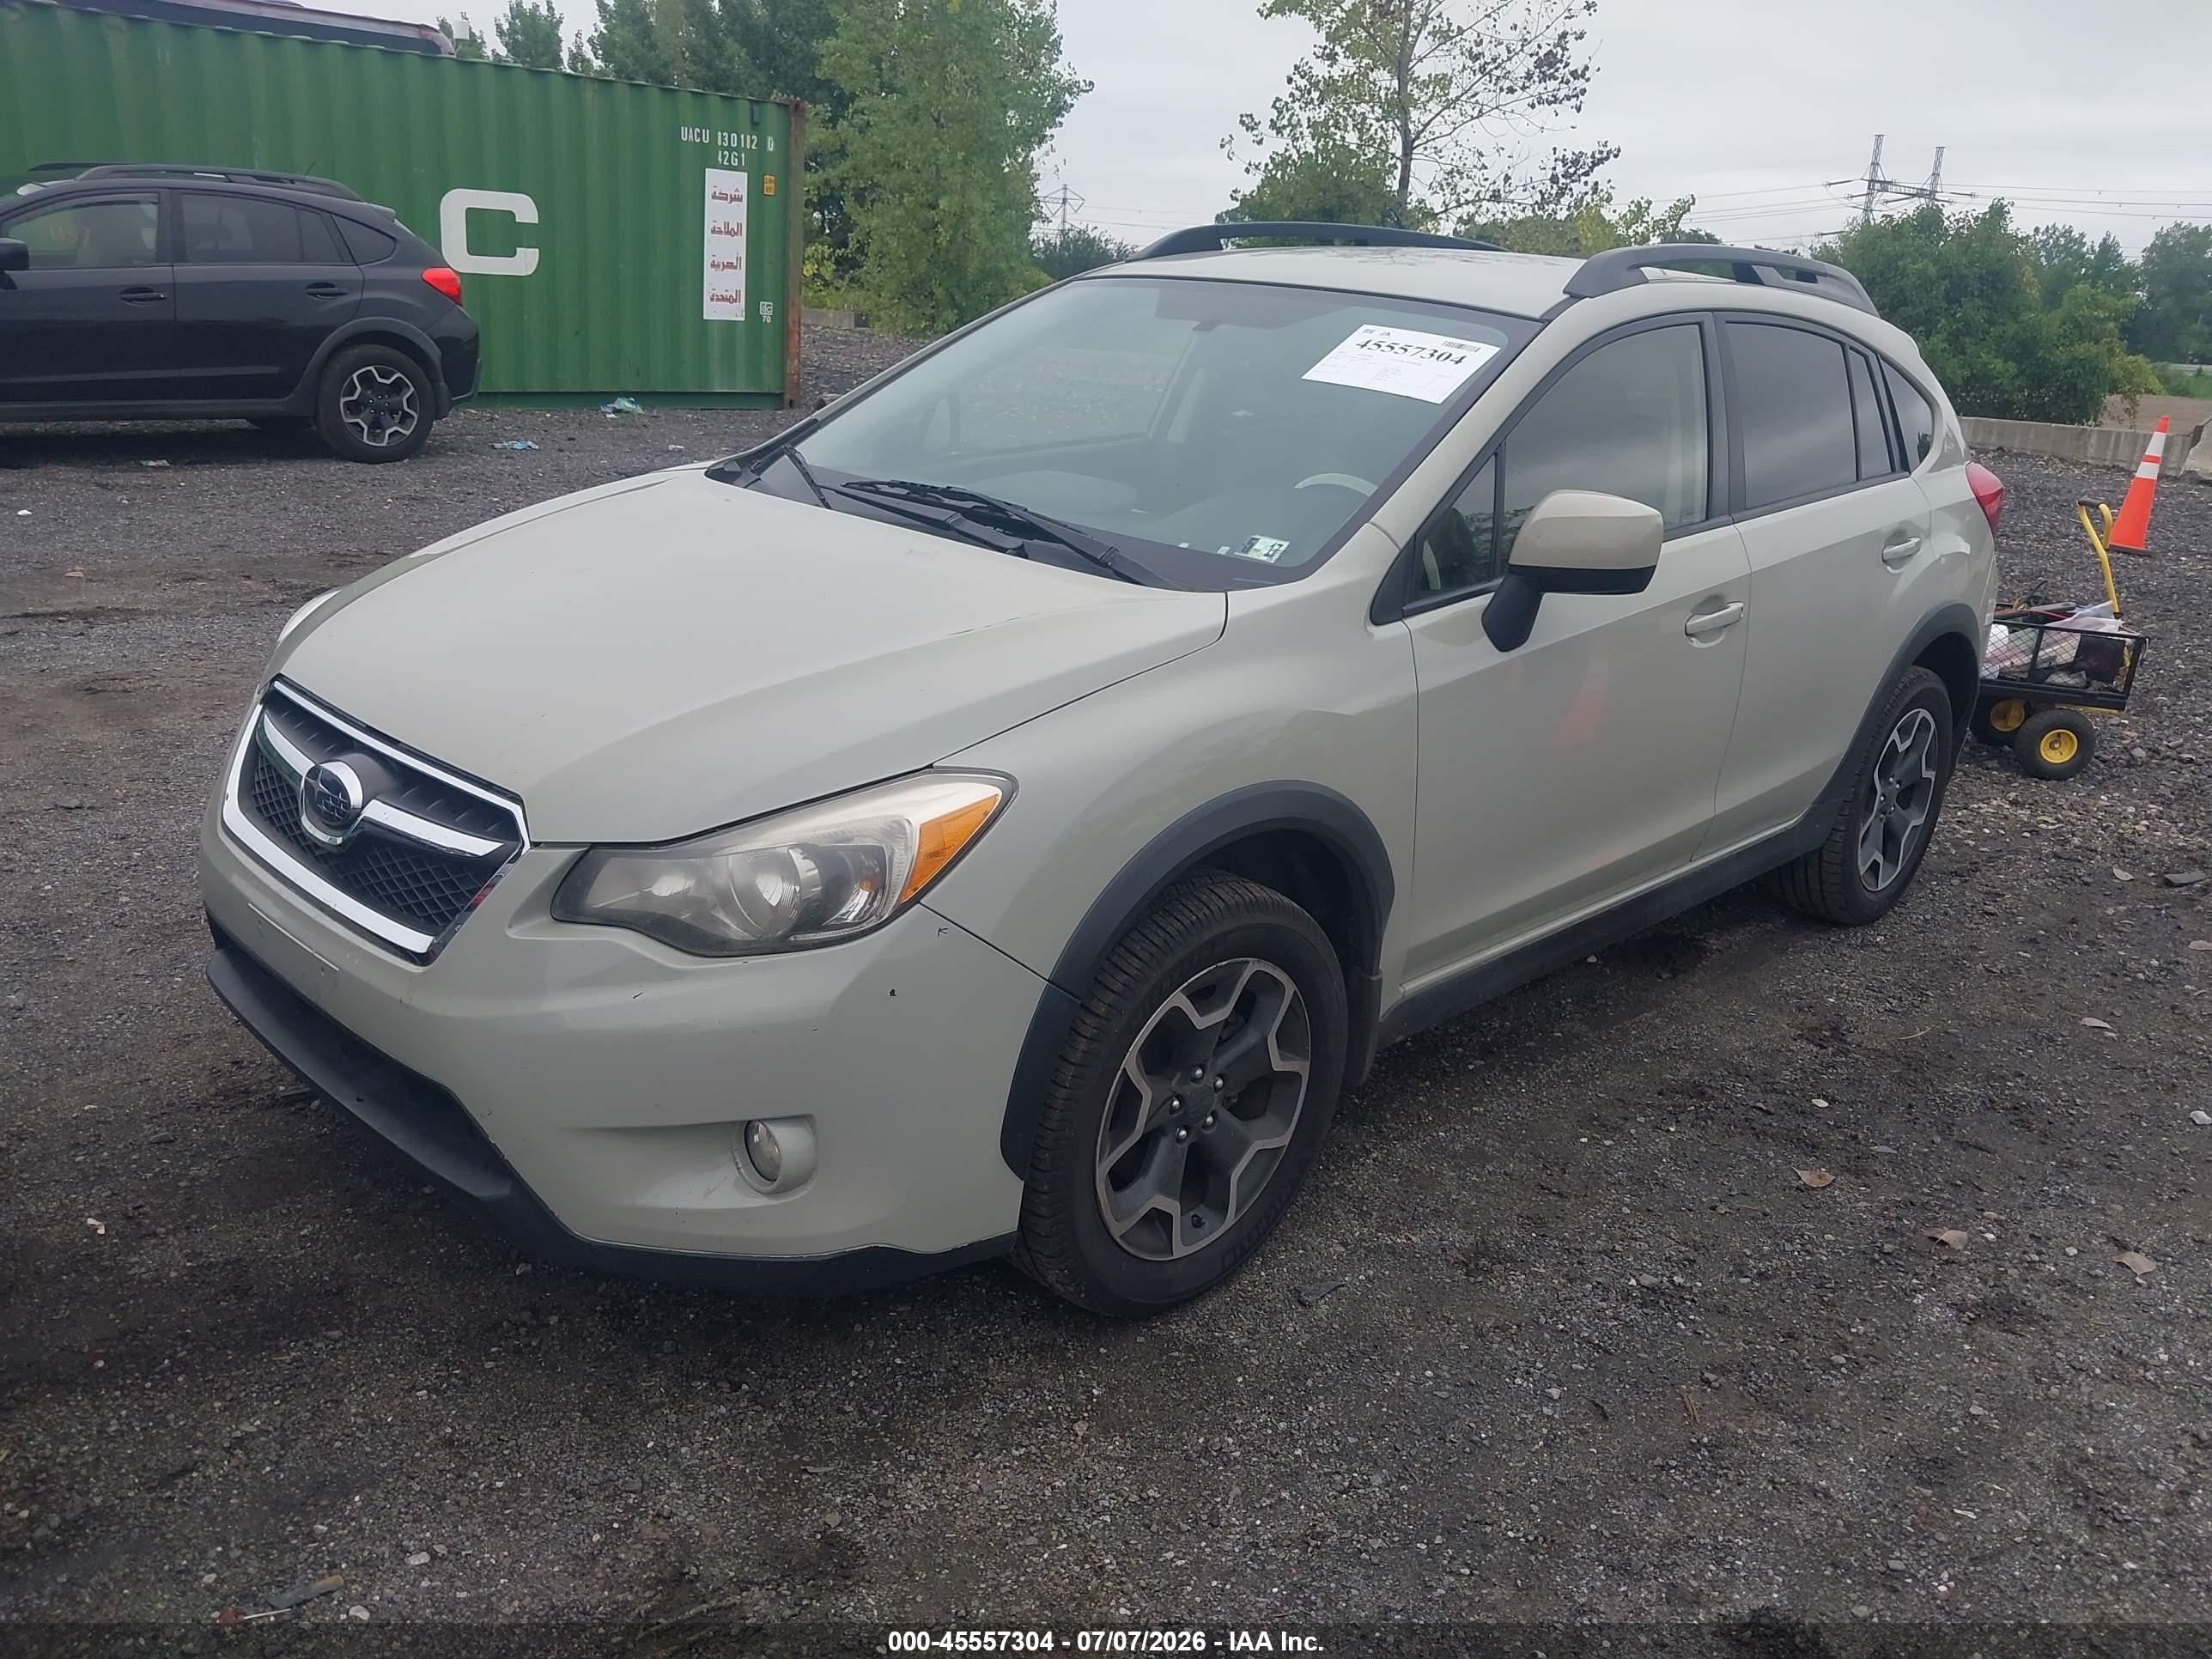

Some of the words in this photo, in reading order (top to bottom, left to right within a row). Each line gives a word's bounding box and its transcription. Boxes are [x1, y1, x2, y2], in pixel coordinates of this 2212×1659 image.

[681, 126, 710, 143] UACU
[717, 131, 757, 149] 830182
[717, 150, 745, 167] 42G1
[711, 185, 743, 204] شركة
[440, 188, 539, 276] C
[710, 221, 743, 238] الملاحة
[709, 253, 742, 272] العربية
[709, 289, 742, 305] المتحدة
[762, 315, 772, 324] 70
[1355, 338, 1468, 365] 45557304
